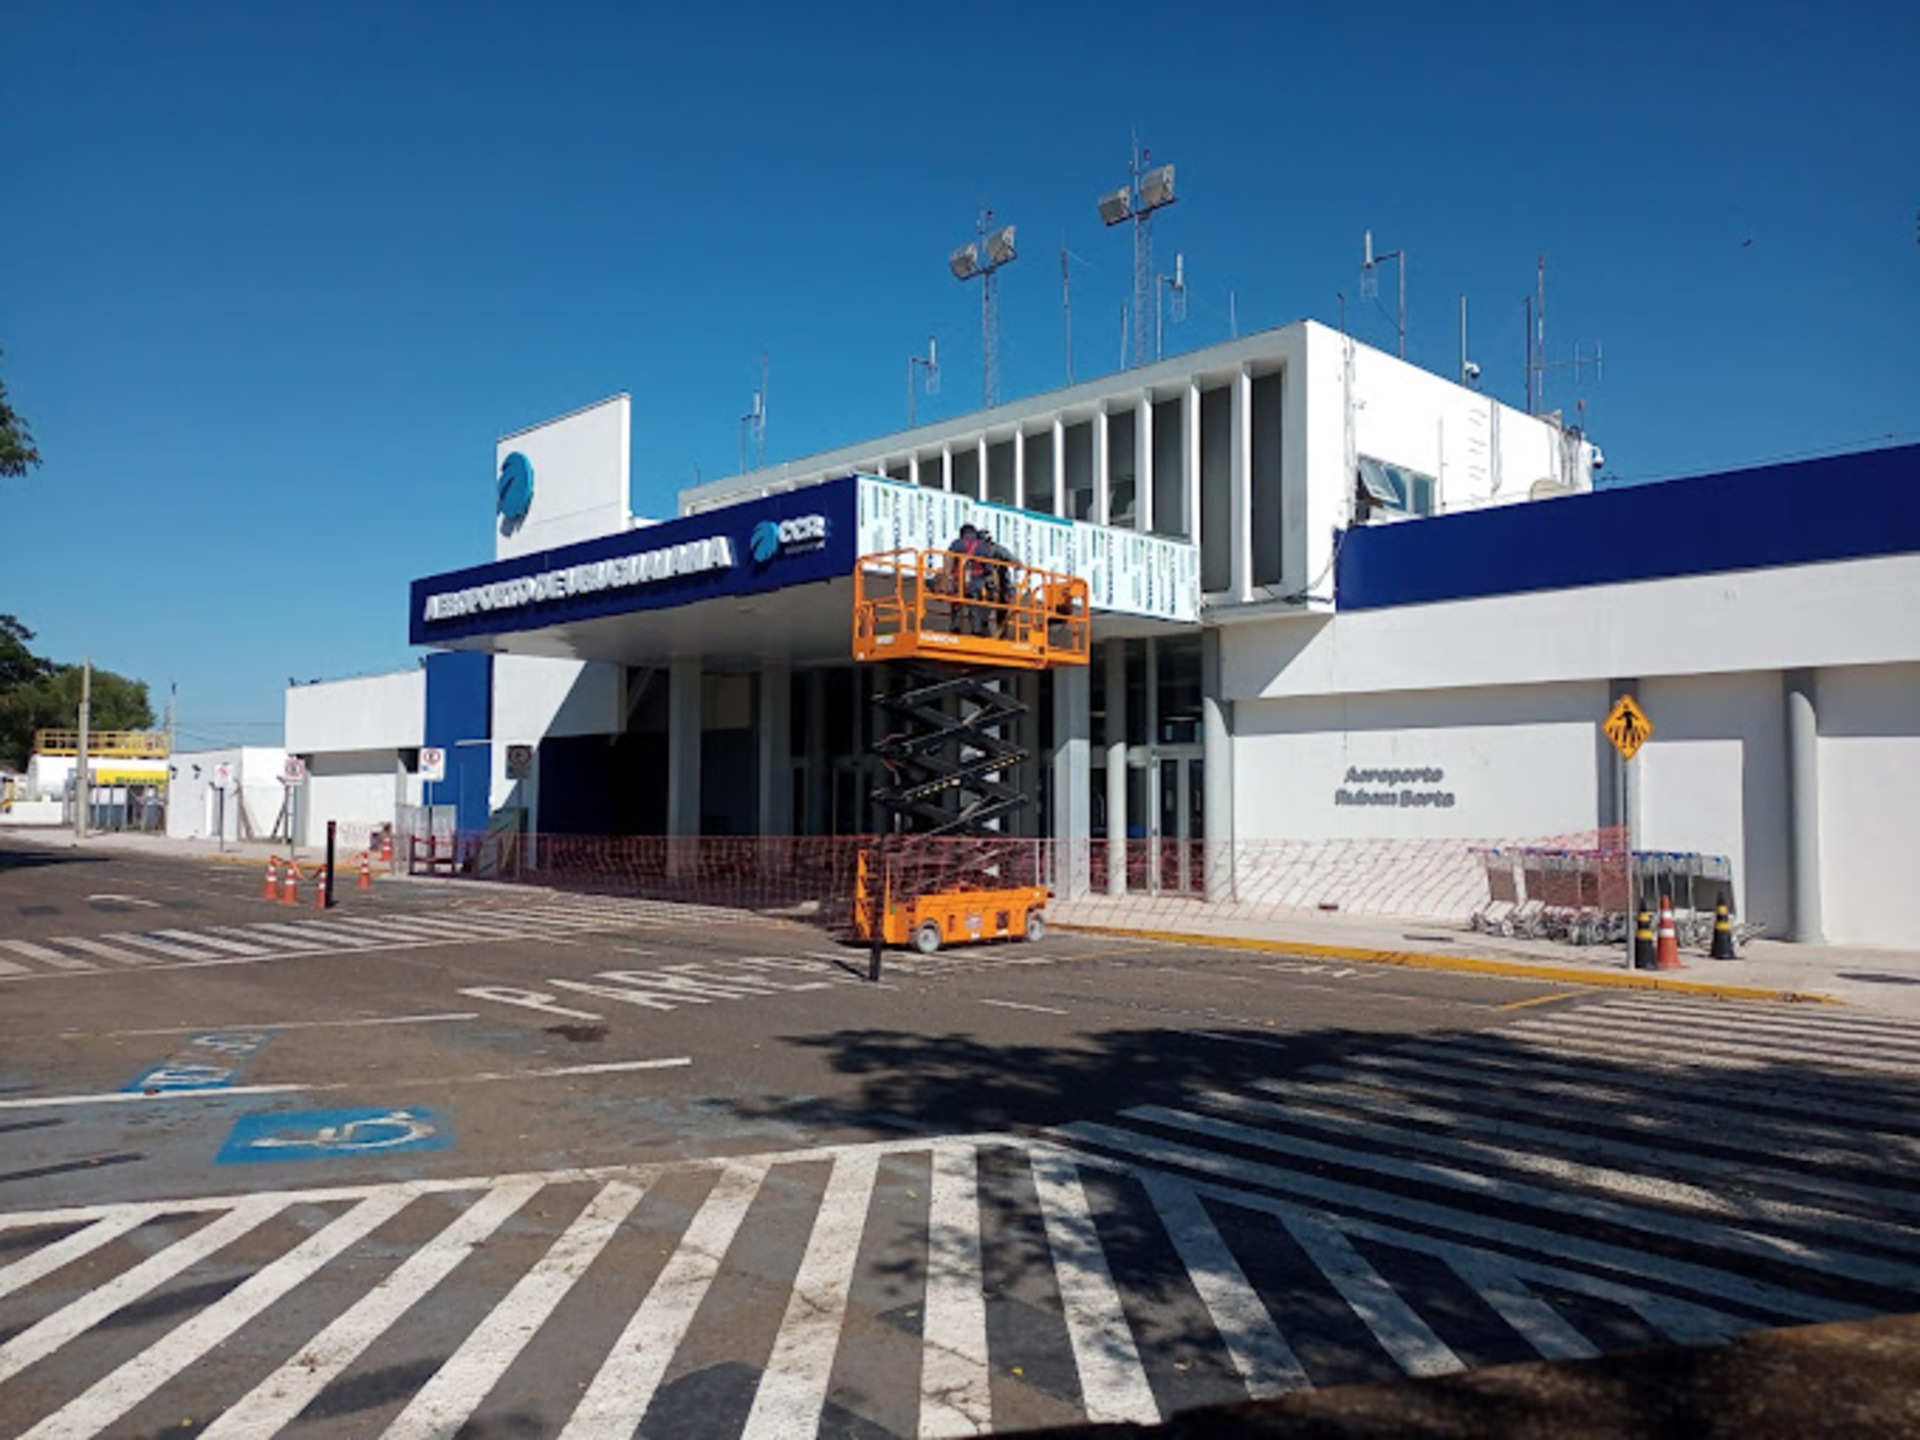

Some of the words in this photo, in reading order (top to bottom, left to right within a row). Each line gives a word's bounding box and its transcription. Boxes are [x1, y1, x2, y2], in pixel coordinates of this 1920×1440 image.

[778, 514, 825, 543] CCR
[423, 576, 536, 622] AEROPORTO
[535, 569, 566, 602] DE
[565, 535, 732, 595] URUGUAIANA
[1343, 764, 1444, 788] Aeroporto
[1399, 788, 1455, 808] Berta
